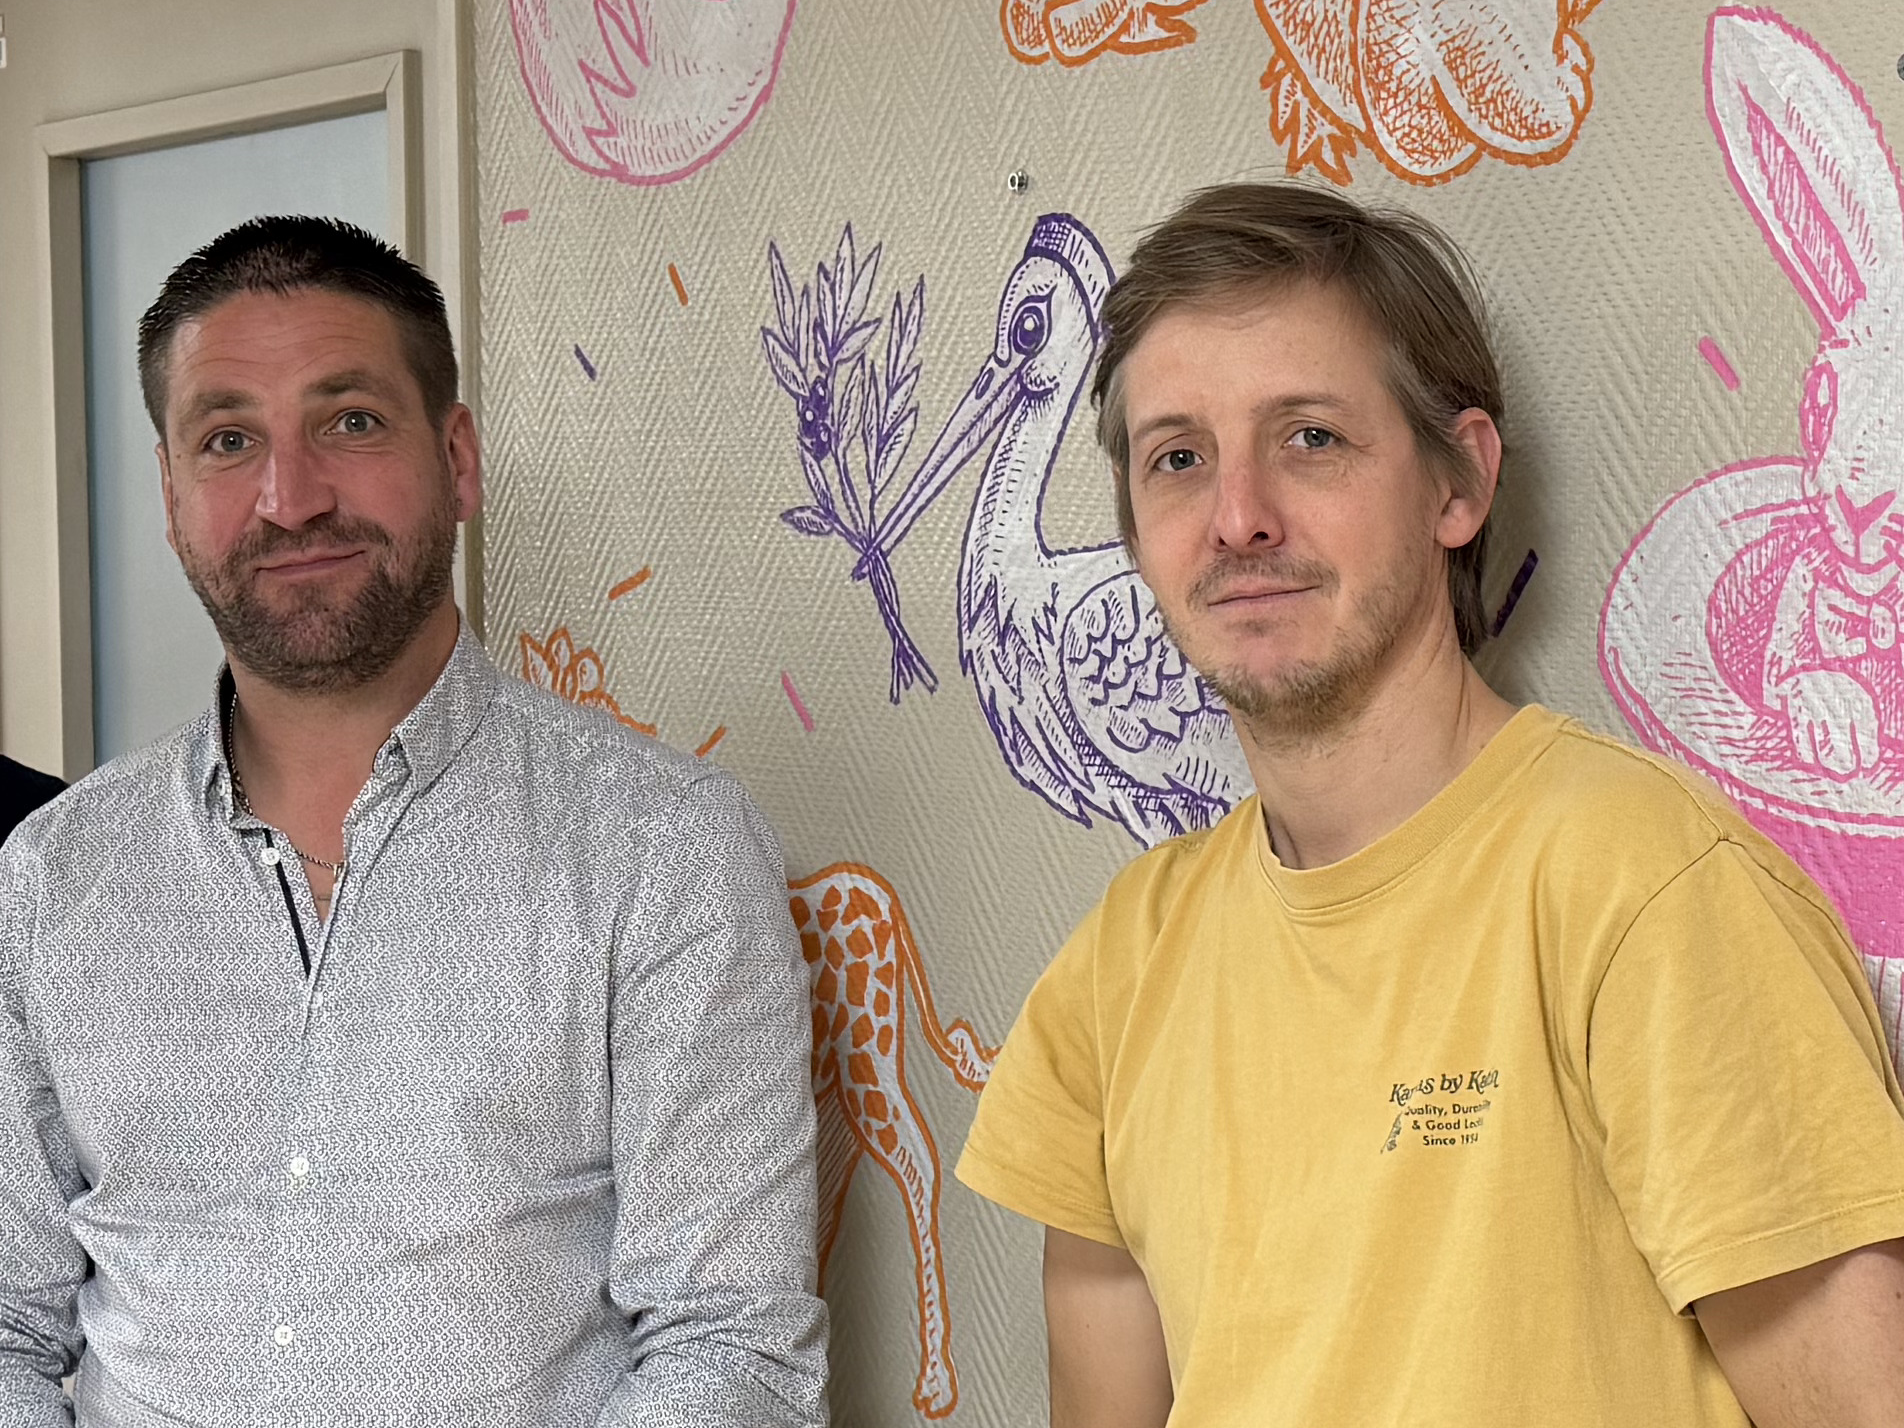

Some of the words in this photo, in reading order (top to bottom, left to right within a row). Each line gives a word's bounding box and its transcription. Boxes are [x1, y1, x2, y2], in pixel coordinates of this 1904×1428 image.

[1440, 1073, 1463, 1094] by
[1412, 1120, 1421, 1130] &
[1426, 1119, 1460, 1130] Good
